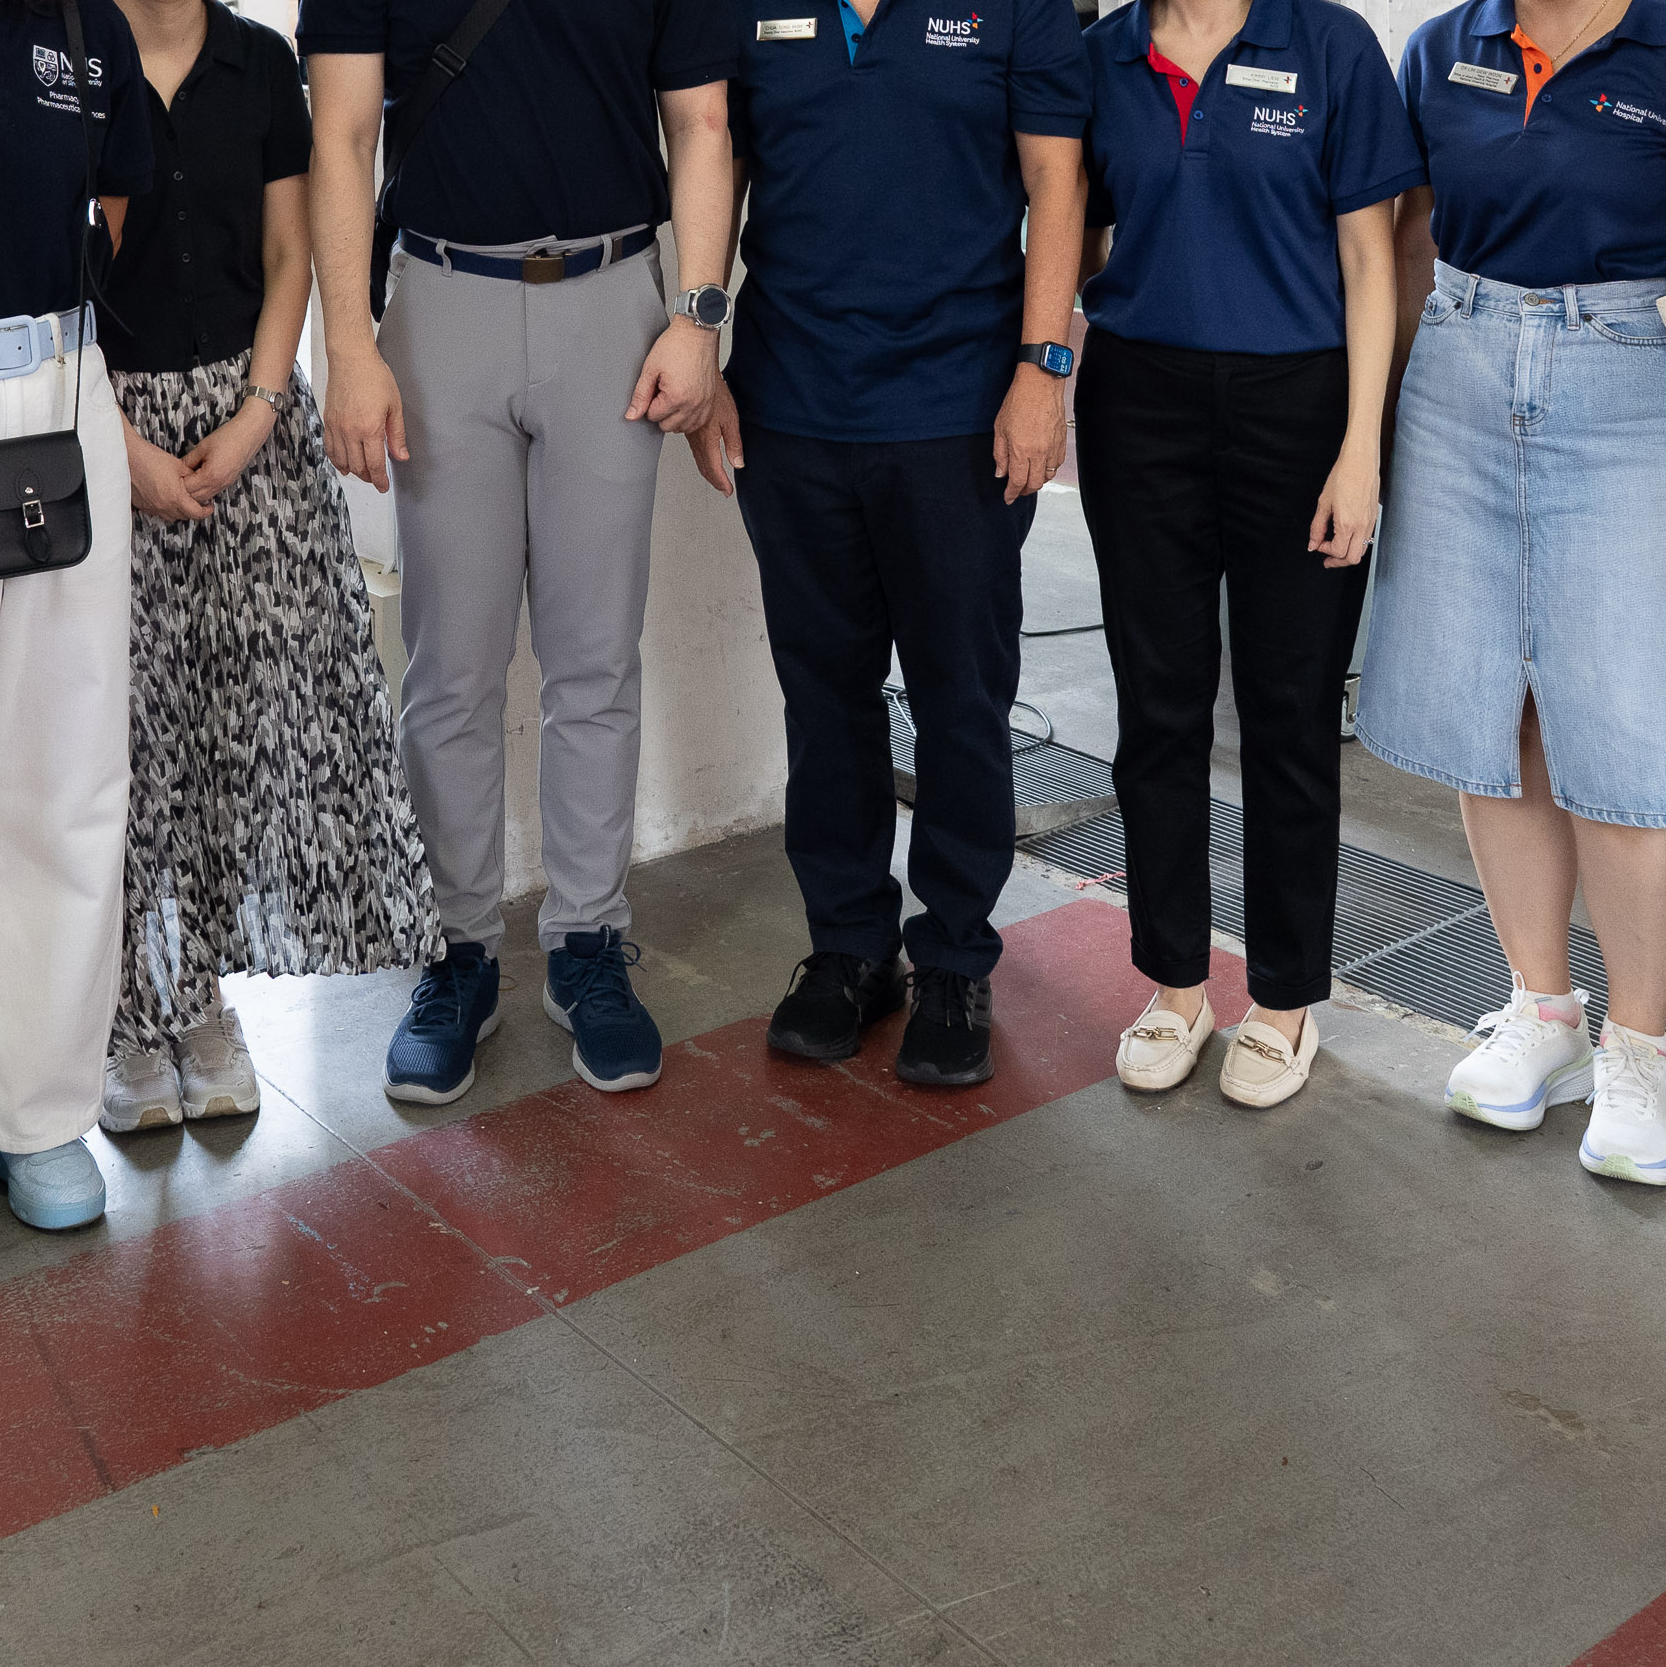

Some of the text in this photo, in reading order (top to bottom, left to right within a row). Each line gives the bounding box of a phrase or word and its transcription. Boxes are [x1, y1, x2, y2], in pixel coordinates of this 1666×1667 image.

[928, 17, 971, 34] NUHS
[925, 32, 980, 45] National University
[925, 38, 945, 46] Health
[1254, 106, 1296, 125] NUHS
[1613, 108, 1643, 123] Hospital
[1616, 100, 1647, 117] National
[1251, 121, 1304, 133] National University
